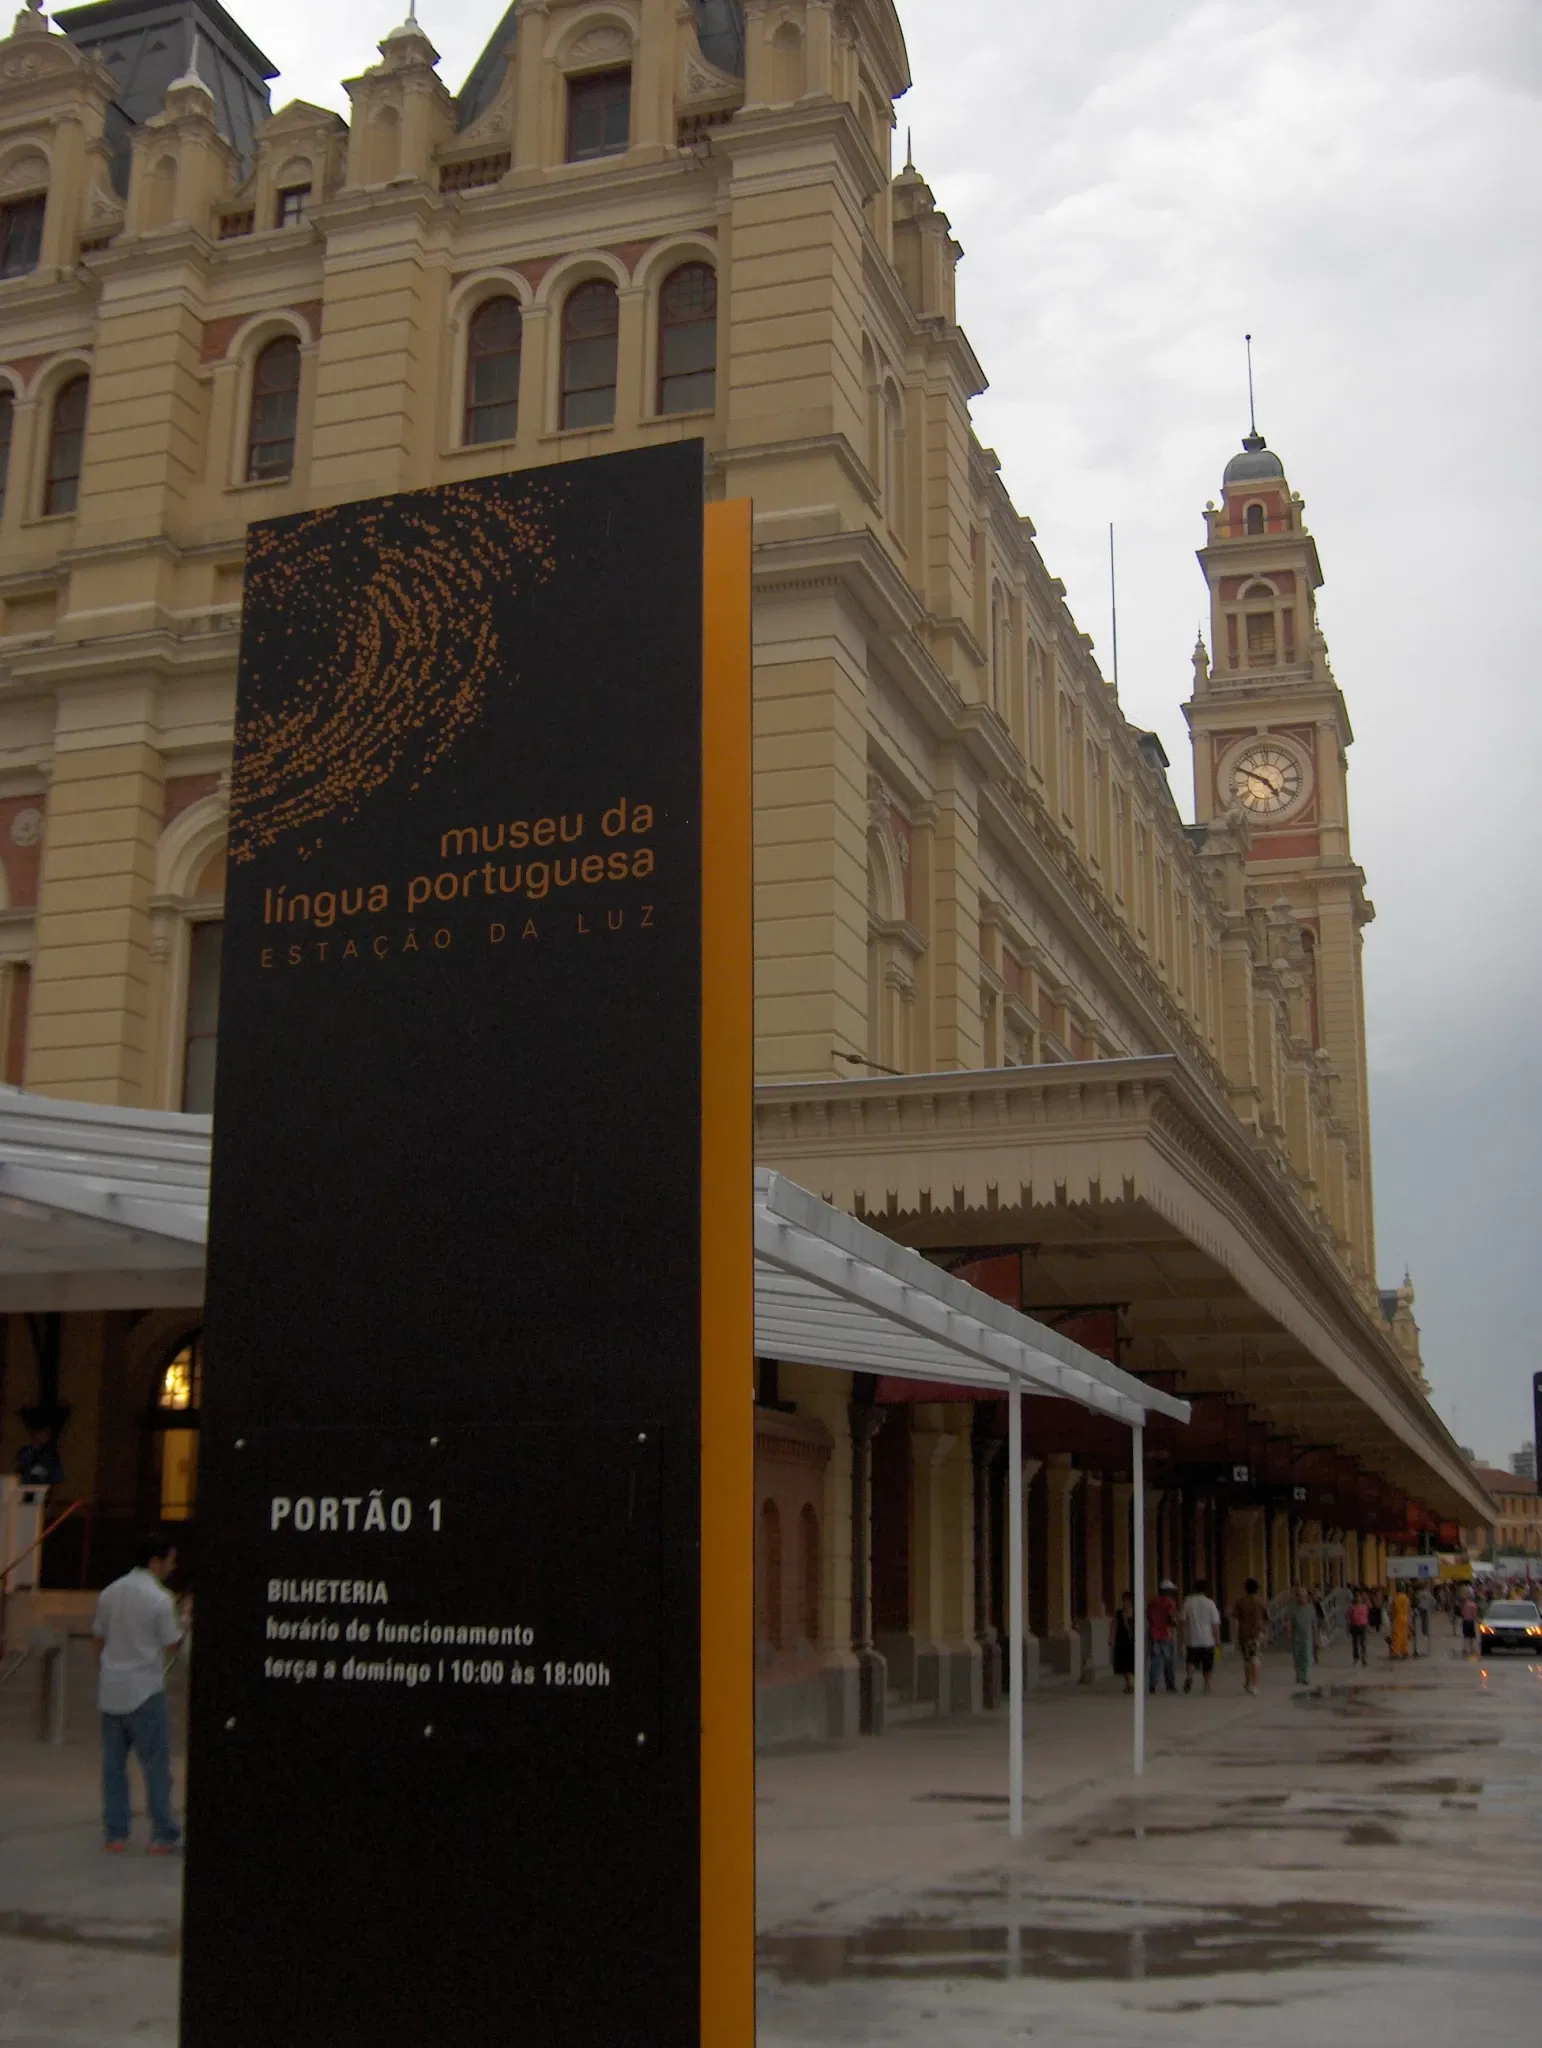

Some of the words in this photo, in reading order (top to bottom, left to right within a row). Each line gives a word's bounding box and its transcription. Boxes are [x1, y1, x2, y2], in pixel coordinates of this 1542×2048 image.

[439, 814, 584, 859] museu
[600, 796, 654, 838] da
[264, 882, 389, 928] língua
[407, 847, 656, 914] portuguesa
[260, 925, 452, 969] ESTAÇÃO
[489, 917, 540, 944] DA
[577, 904, 655, 935] LUZ
[270, 1489, 412, 1532] PORTÃO
[428, 1498, 442, 1532] 1
[267, 1578, 389, 1604] BILHETERIA
[265, 1616, 340, 1642] horário
[345, 1617, 371, 1643] de
[376, 1618, 535, 1647] funcionamento
[264, 1656, 318, 1684] terça
[322, 1661, 336, 1679] a
[342, 1657, 431, 1688] domingo
[450, 1659, 504, 1684] 10:00
[510, 1659, 535, 1684] às
[542, 1660, 611, 1687] 18:00h
